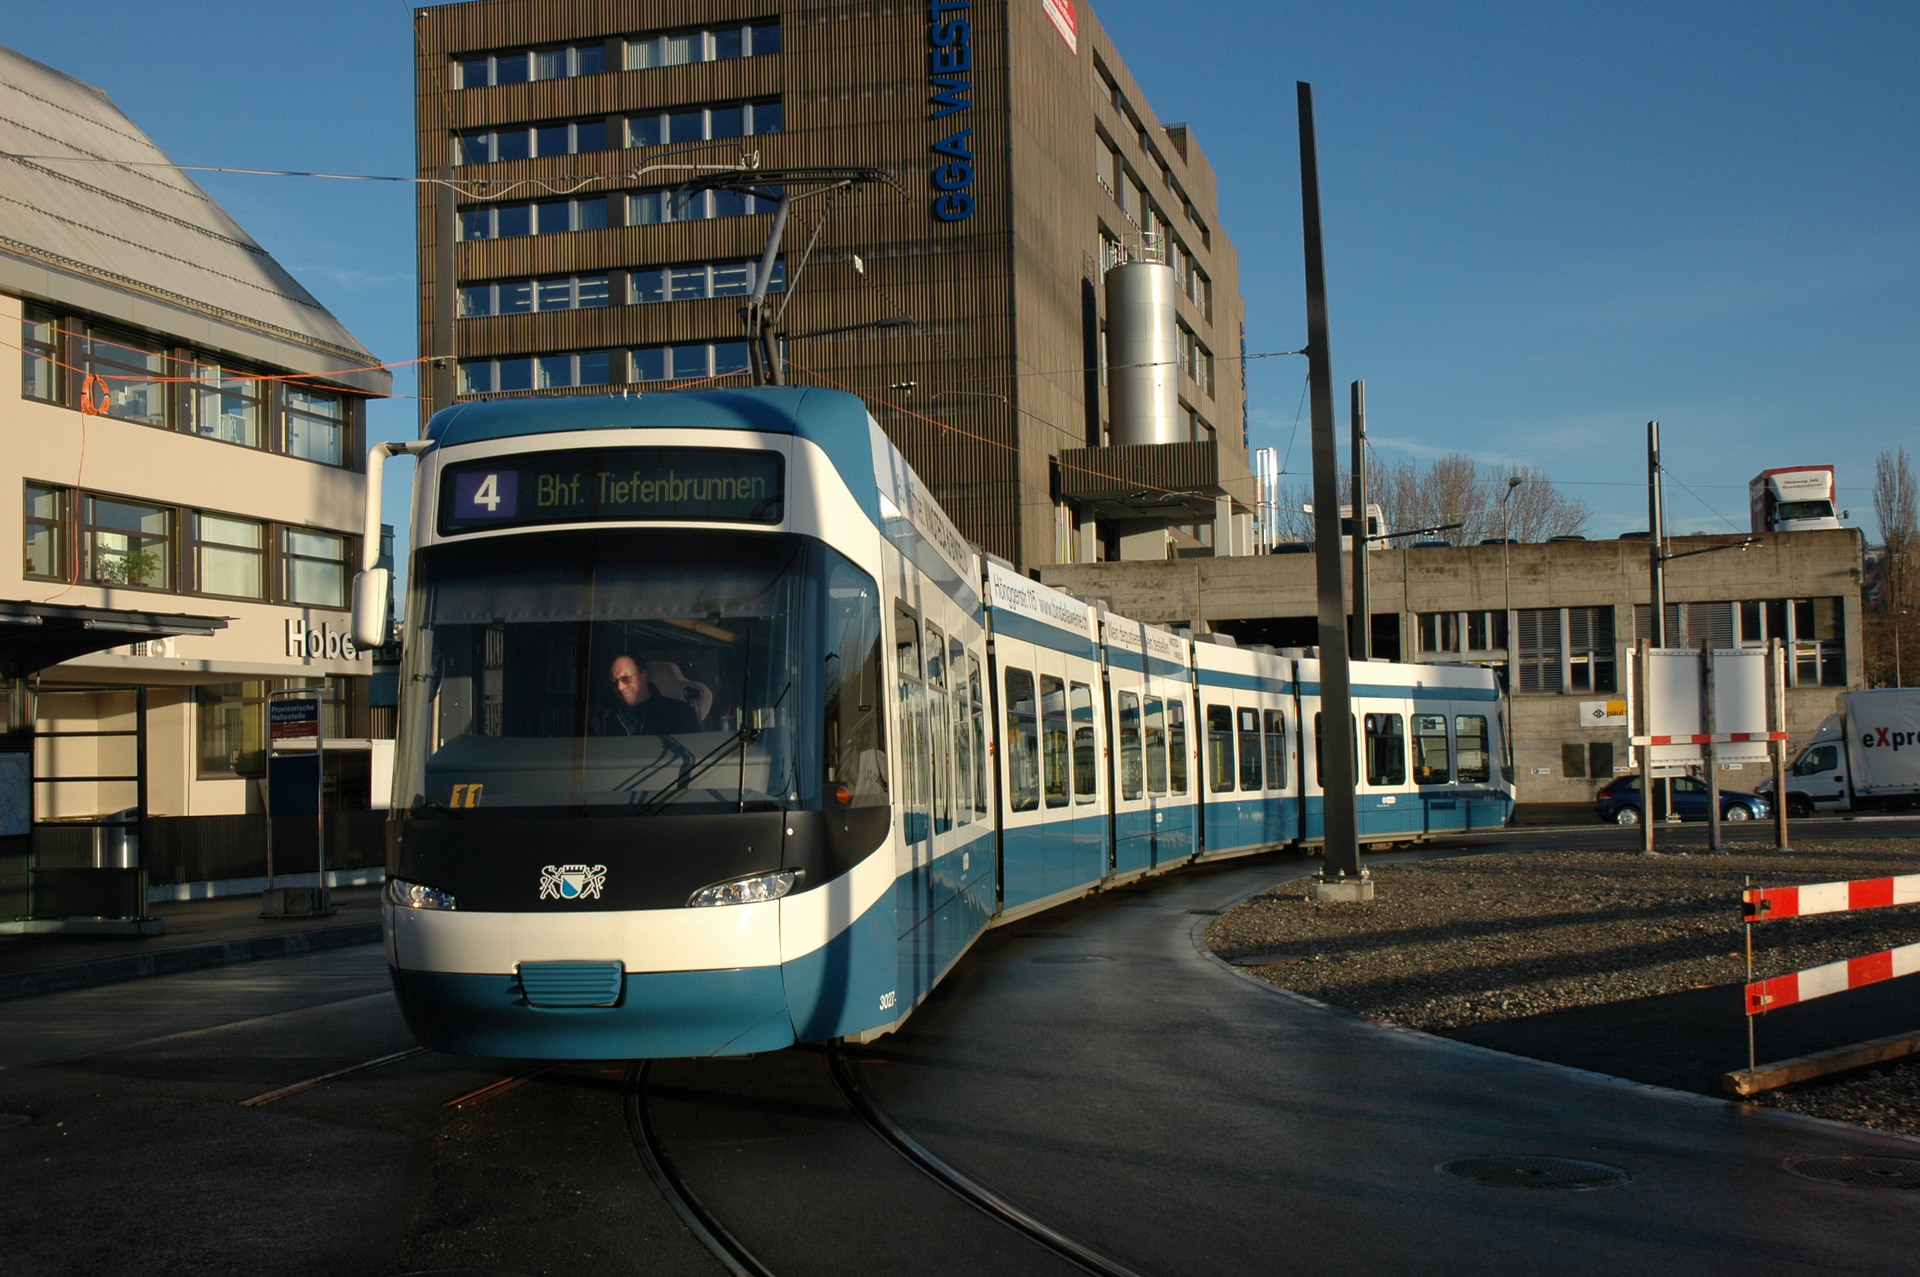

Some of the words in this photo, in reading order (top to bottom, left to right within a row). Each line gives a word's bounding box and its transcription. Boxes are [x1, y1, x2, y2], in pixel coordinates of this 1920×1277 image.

[932, 0, 972, 119] WEST
[935, 127, 975, 222] GGA
[474, 474, 500, 511] 4
[537, 473, 585, 506] Bhf.
[597, 470, 765, 504] Tiefenbrunnen
[286, 619, 363, 660] Hobe
[271, 704, 315, 713] Provisorische
